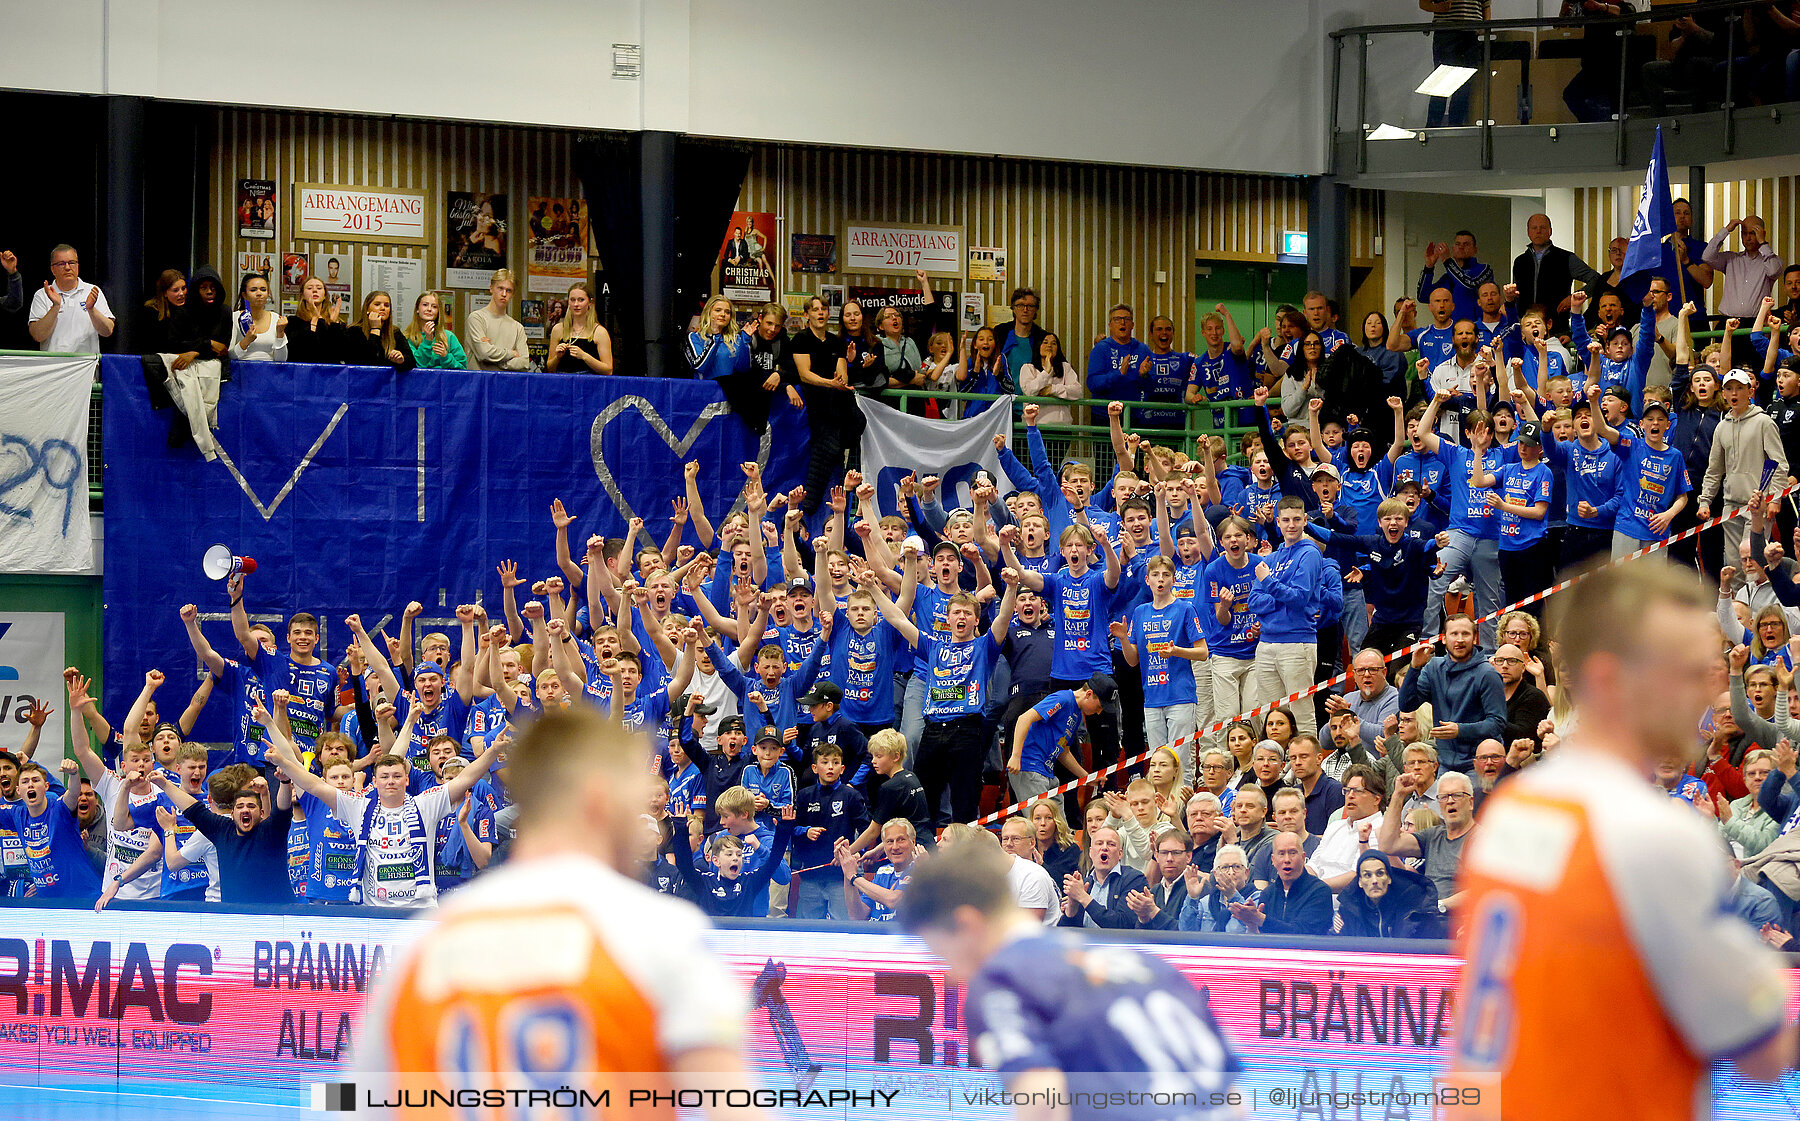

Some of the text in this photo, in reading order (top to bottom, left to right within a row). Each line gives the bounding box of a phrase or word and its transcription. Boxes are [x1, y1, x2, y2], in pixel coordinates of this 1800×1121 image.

[304, 193, 421, 215] ARRANGEMANG
[342, 213, 383, 231] 2015
[851, 231, 956, 250] ARRANGEMANG
[885, 249, 921, 266] 2017
[725, 266, 769, 278] CHRISTMAS
[735, 277, 759, 286] NIGHT
[602, 282, 610, 294] A
[856, 293, 926, 308] Arena Skövde
[1467, 507, 1495, 516] DALOC
[1062, 586, 1073, 598] 20
[1064, 620, 1089, 631] RAPP
[1233, 614, 1257, 625] RAPP
[1064, 639, 1091, 649] DALOC
[848, 669, 874, 682] RAPP
[845, 688, 874, 699] DALOC
[288, 707, 318, 722] VOLVO
[113, 833, 145, 847] VOLVO
[368, 838, 394, 847] DALOC
[379, 852, 414, 860] VOLVO
[44, 1025, 78, 1046] YOU
[83, 1027, 126, 1048] WELL
[132, 1029, 211, 1053] EQUIPPED
[276, 1009, 355, 1061] ALLA
[1107, 989, 1226, 1104] 10
